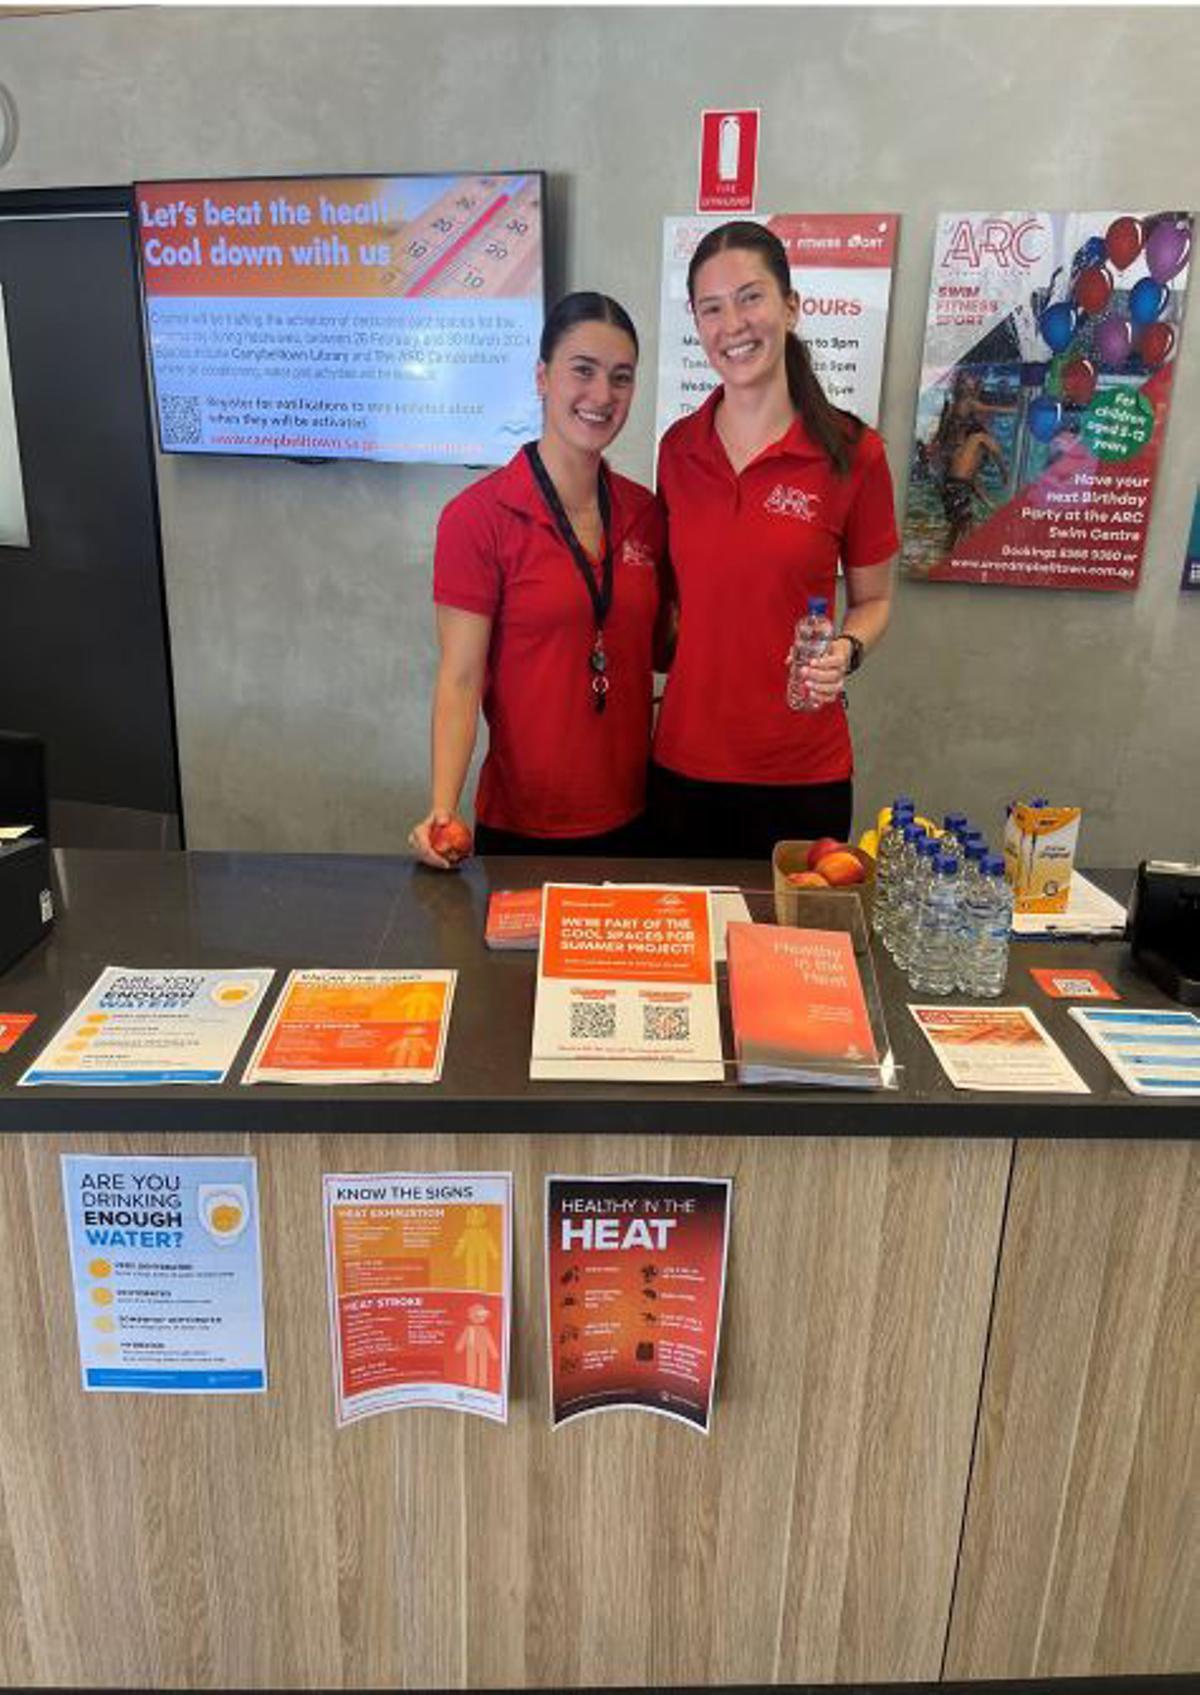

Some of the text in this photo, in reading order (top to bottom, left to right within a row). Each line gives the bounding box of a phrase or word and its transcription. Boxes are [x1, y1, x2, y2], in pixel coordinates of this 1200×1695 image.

[140, 200, 198, 227] Let's
[204, 198, 262, 225] beat
[269, 197, 312, 225] the
[145, 235, 391, 266] Cool down with us
[939, 219, 1045, 267] ARC
[801, 299, 862, 316] OURS
[257, 397, 273, 408] for
[244, 414, 267, 428] they
[271, 415, 293, 427] will
[295, 416, 309, 427] be
[1074, 473, 1149, 489] Have your
[1047, 491, 1147, 508] next Birthday
[1022, 507, 1144, 524] Party at the ARC
[1049, 526, 1140, 542] Swim Centre
[605, 918, 637, 929] PART
[643, 919, 662, 930] OF
[667, 919, 692, 930] THE
[561, 929, 603, 939] COOL
[606, 931, 664, 941] SPACES
[560, 941, 624, 953] SUMMER
[80, 1174, 180, 1192] ARE YOU
[81, 1192, 182, 1210] DRINKING
[337, 1185, 473, 1200] KNOW THE SIGNS
[561, 1199, 697, 1213] HEALTHY IN THE
[84, 1211, 183, 1228] ENOUGH
[85, 1230, 184, 1248] WATER?
[561, 1219, 677, 1250] HEAT
[377, 1297, 423, 1308] STROKE
